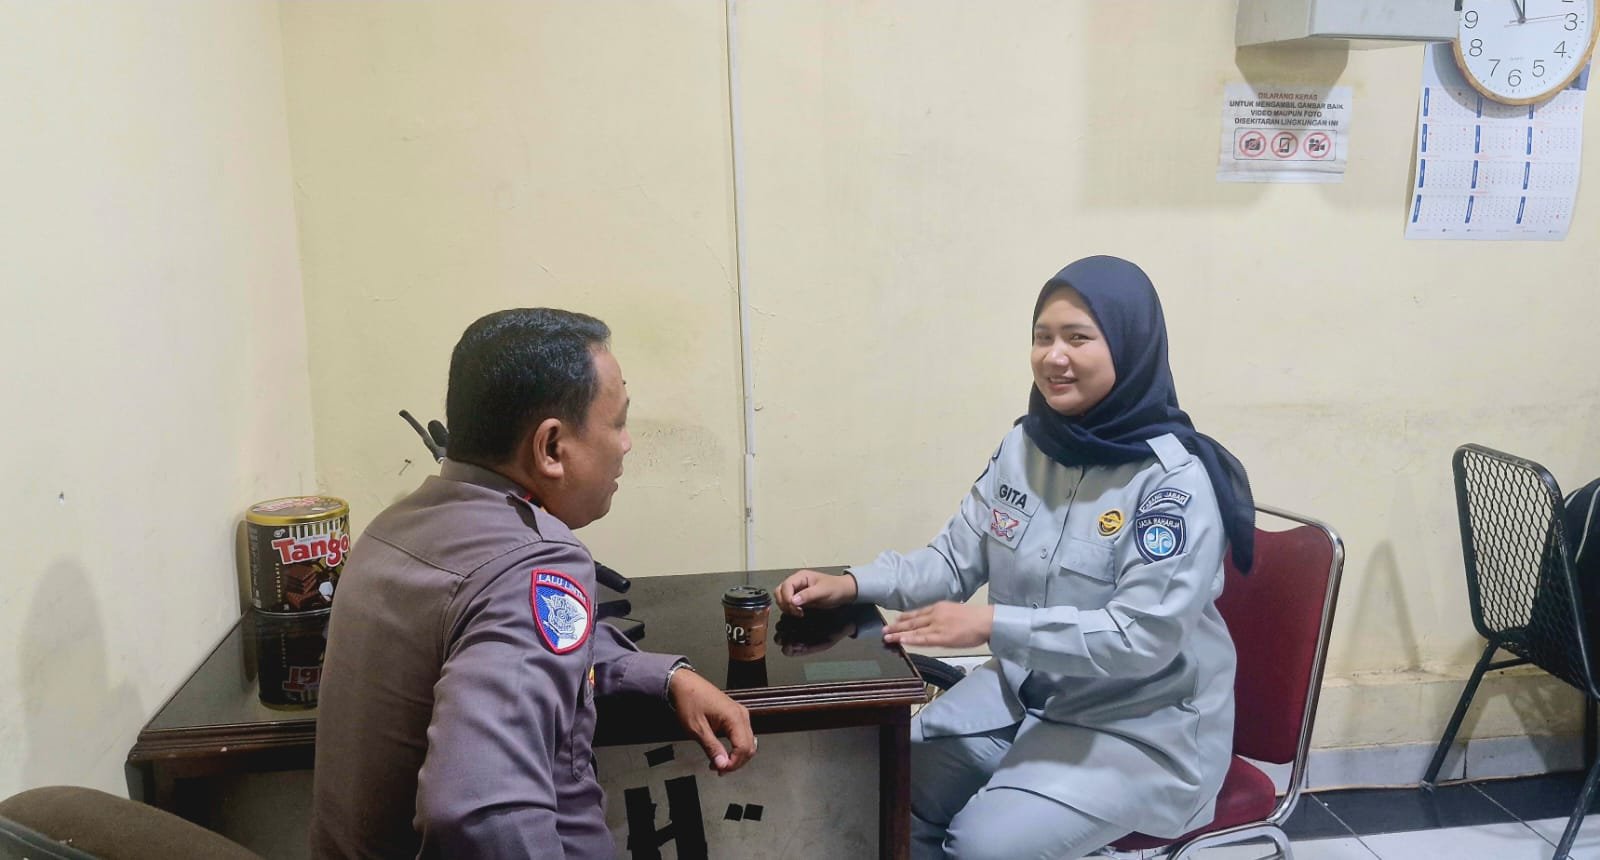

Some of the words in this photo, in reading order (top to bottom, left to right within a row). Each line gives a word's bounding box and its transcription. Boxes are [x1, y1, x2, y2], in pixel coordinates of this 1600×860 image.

[1464, 10, 1478, 29] 9
[1563, 12, 1578, 31] 3
[1469, 38, 1483, 57] 8
[1553, 40, 1567, 58] 4
[1488, 59, 1501, 77] 7
[1532, 59, 1545, 78] 5
[1507, 69, 1522, 87] 6
[1255, 101, 1296, 109] MENGAMBIL
[1258, 92, 1294, 100] DILARANG
[1295, 93, 1318, 101] KERAS
[1234, 117, 1280, 125] DISEKITARAN
[999, 484, 1028, 509] GITA
[1138, 520, 1153, 529] JASA
[272, 533, 349, 566] Tango
[538, 574, 563, 586] LALU
